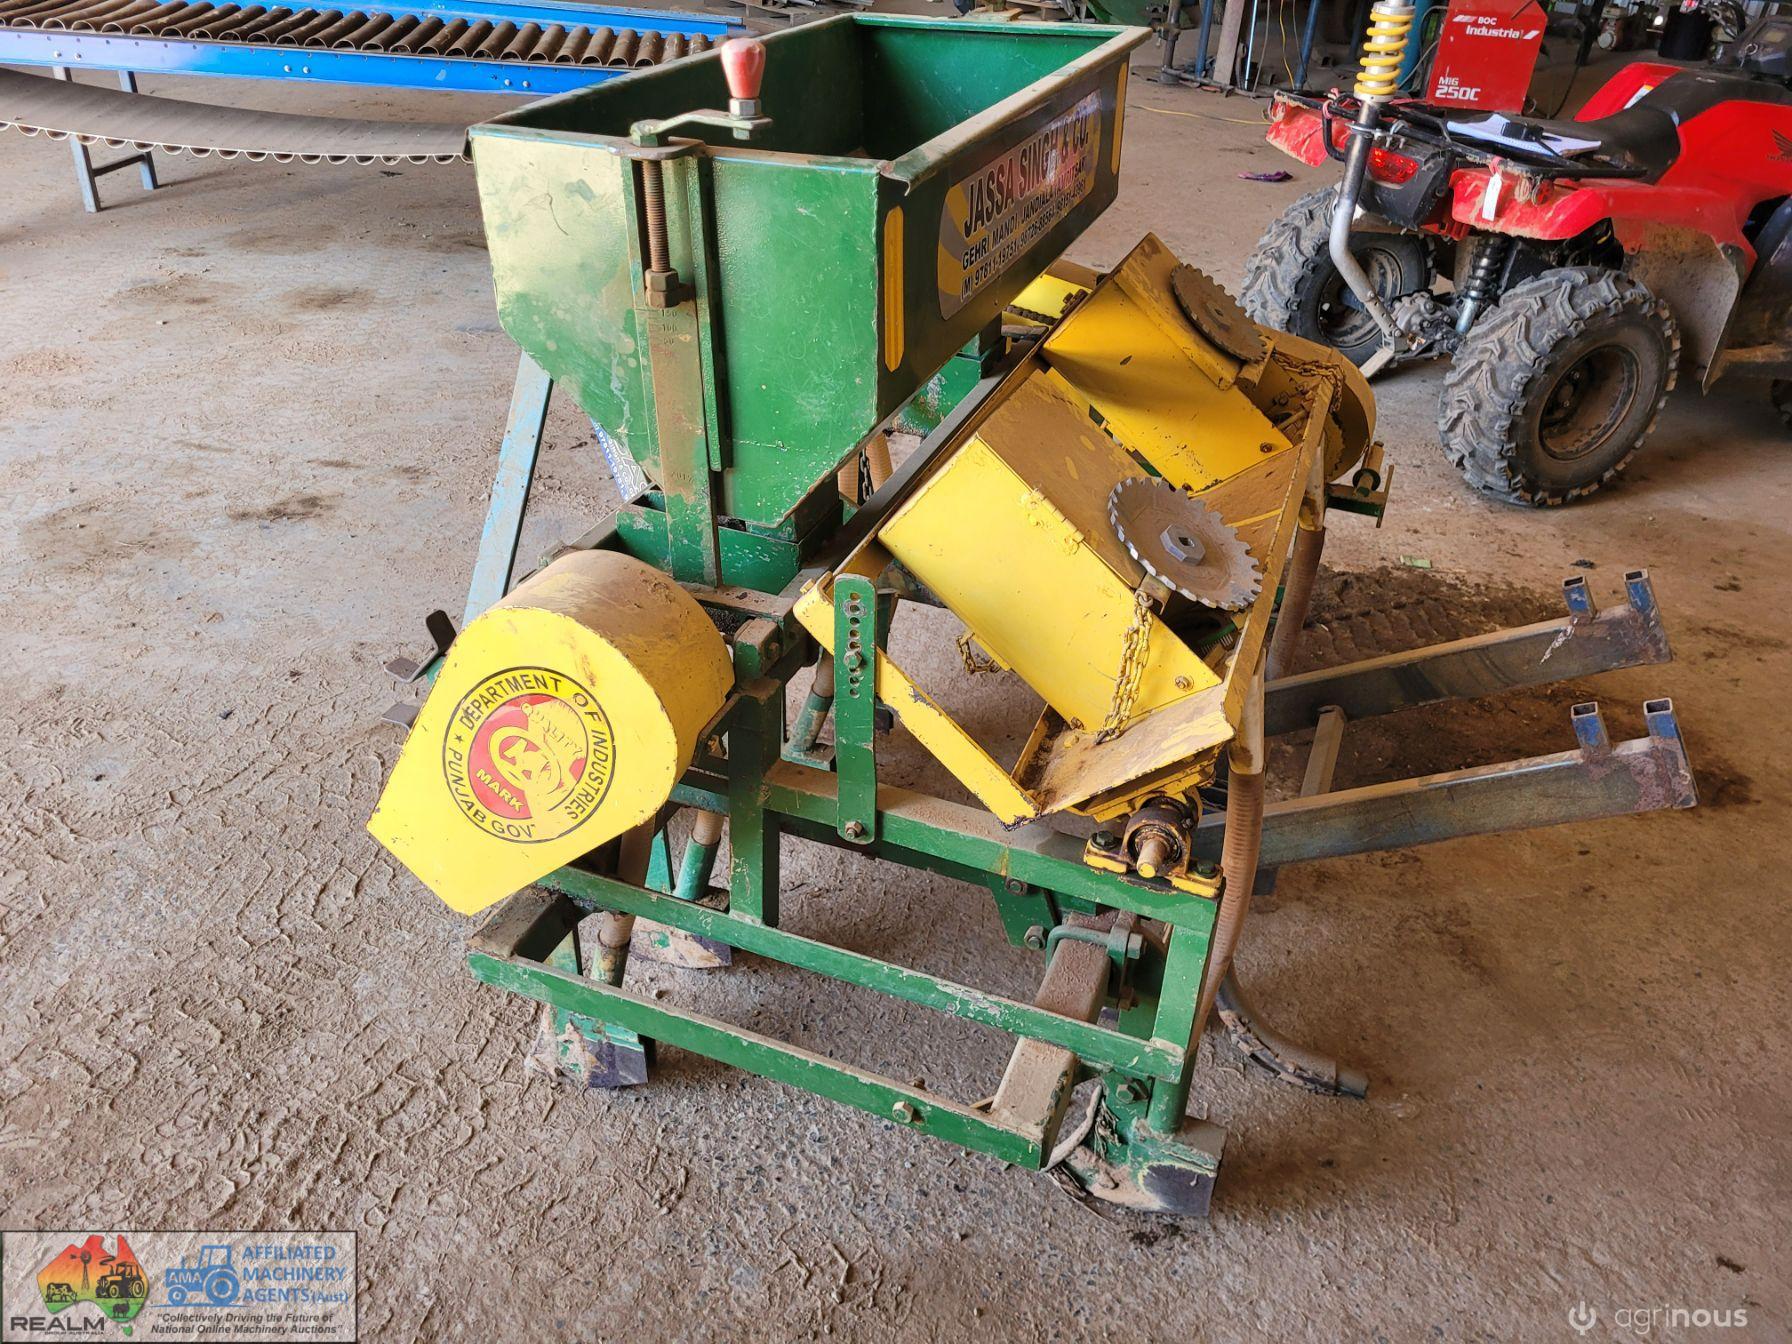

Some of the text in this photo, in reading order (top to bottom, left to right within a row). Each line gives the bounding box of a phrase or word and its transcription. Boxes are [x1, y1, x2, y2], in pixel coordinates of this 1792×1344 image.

[1477, 16, 1497, 25] BOC
[1435, 85, 1481, 101] 250C
[1439, 76, 1459, 86] MIG
[963, 158, 1015, 239] JASSA
[1018, 125, 1059, 199] SINGH
[1061, 121, 1069, 163] &
[962, 234, 990, 271] GEHRI
[459, 673, 609, 821] DEPARTMENT OF INDUSTRIES
[448, 747, 536, 839] PUNJAB GOV
[476, 768, 525, 813] MARK
